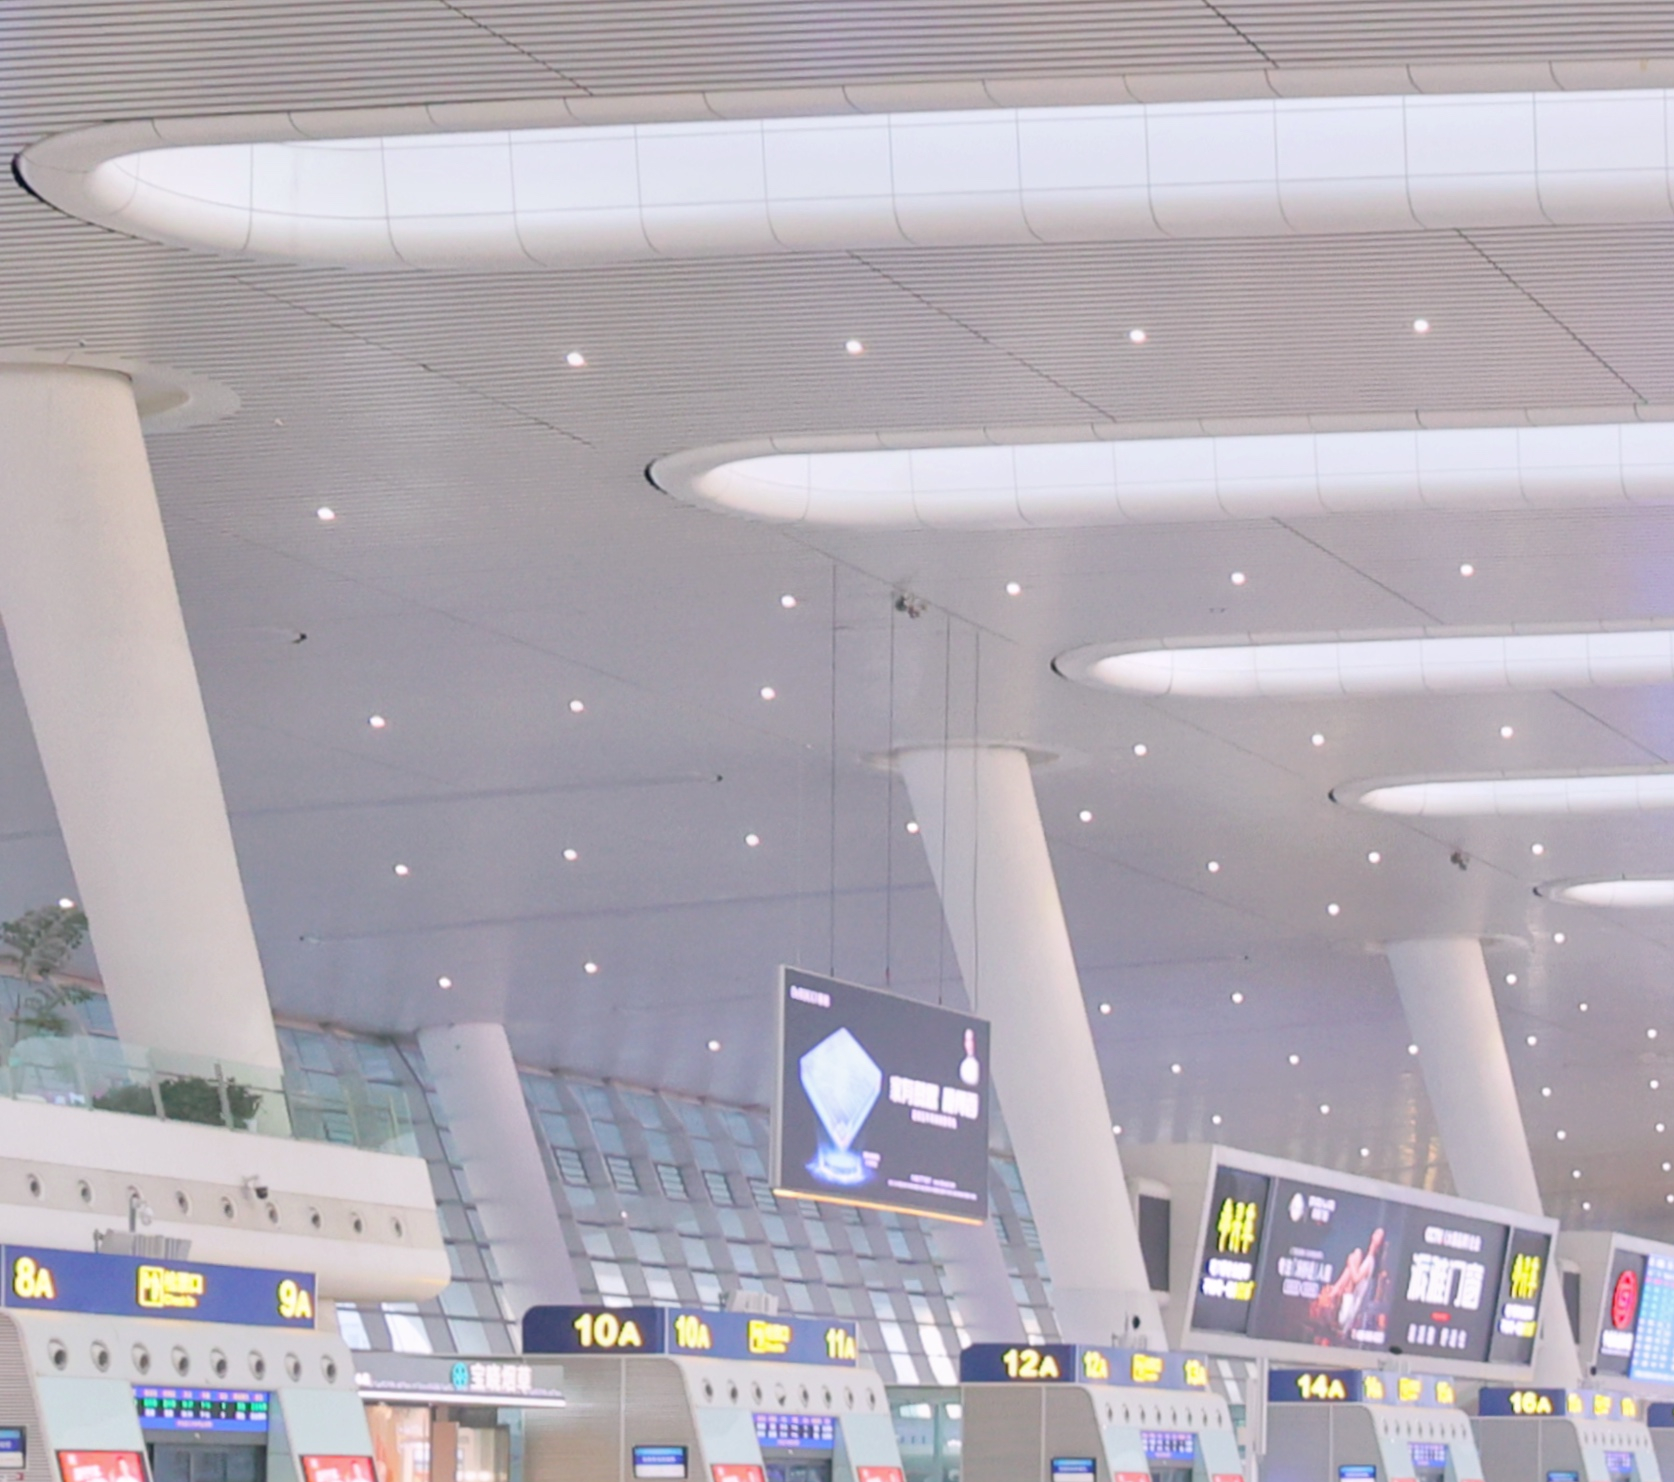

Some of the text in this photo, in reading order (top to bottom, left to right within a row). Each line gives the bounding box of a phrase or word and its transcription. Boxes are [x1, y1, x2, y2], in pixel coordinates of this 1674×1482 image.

[14, 1256, 54, 1299] 8A
[278, 1279, 313, 1319] 9A
[574, 1313, 643, 1349] 10A
[674, 1315, 713, 1348] 10A
[826, 1327, 857, 1360] 11A
[1003, 1349, 1059, 1378] 12A
[1297, 1373, 1346, 1399] 14A
[1510, 1391, 1553, 1414] 16A
